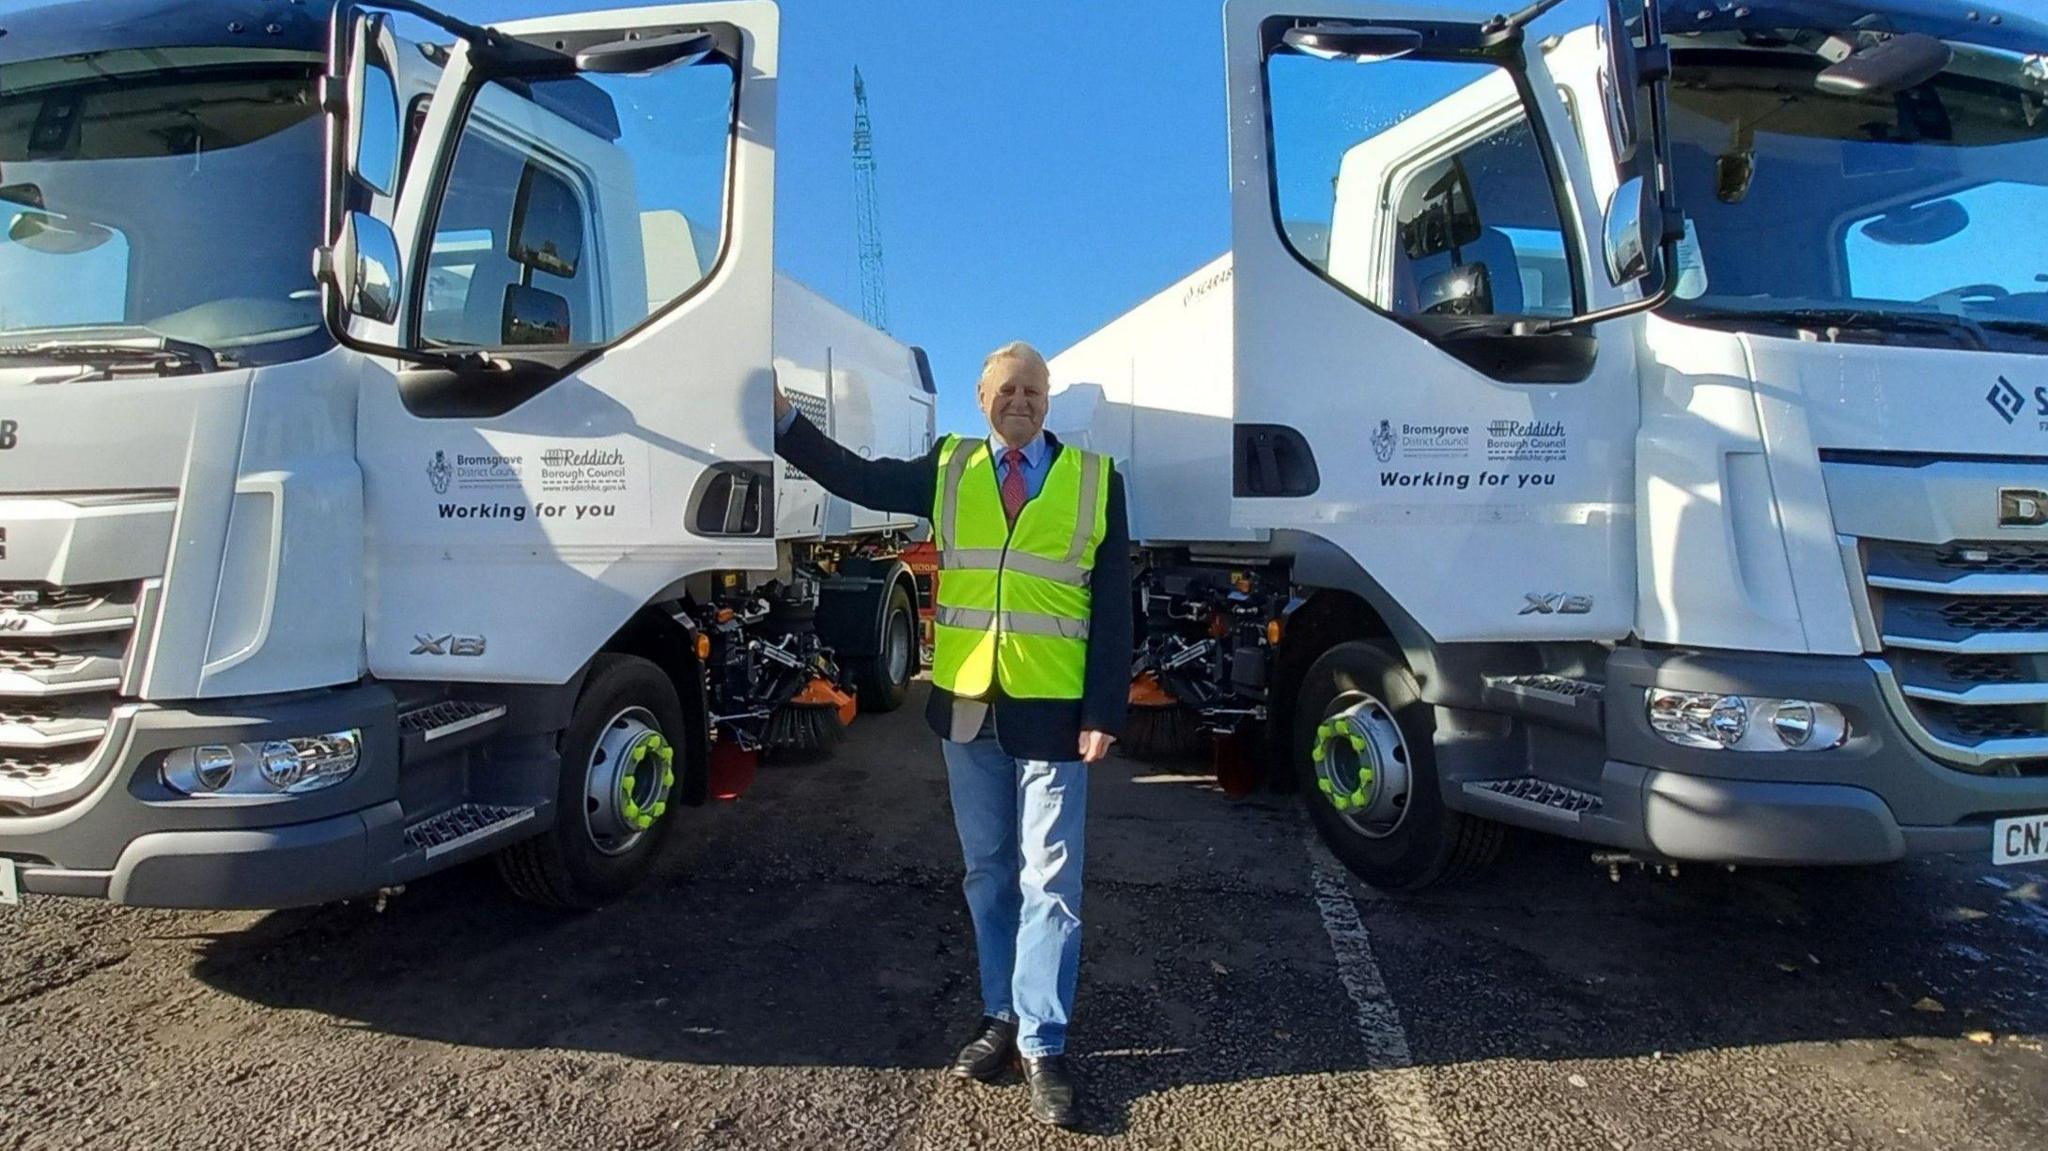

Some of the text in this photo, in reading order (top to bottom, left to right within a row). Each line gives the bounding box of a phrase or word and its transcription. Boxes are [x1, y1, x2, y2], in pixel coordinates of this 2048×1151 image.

[1402, 424, 1469, 438] Bromsgrove
[1508, 420, 1567, 437] Redditch
[1402, 437, 1469, 447] District Council
[1487, 438, 1566, 452] Borough Council
[457, 454, 523, 468] Bromsgrove
[563, 449, 625, 467] Redditch
[457, 467, 523, 478] District Council
[541, 467, 626, 481] Borough Council
[1380, 471, 1556, 489] Working for you
[438, 502, 616, 521] Working for you
[1517, 592, 1594, 615] XB
[409, 633, 487, 656] XB
